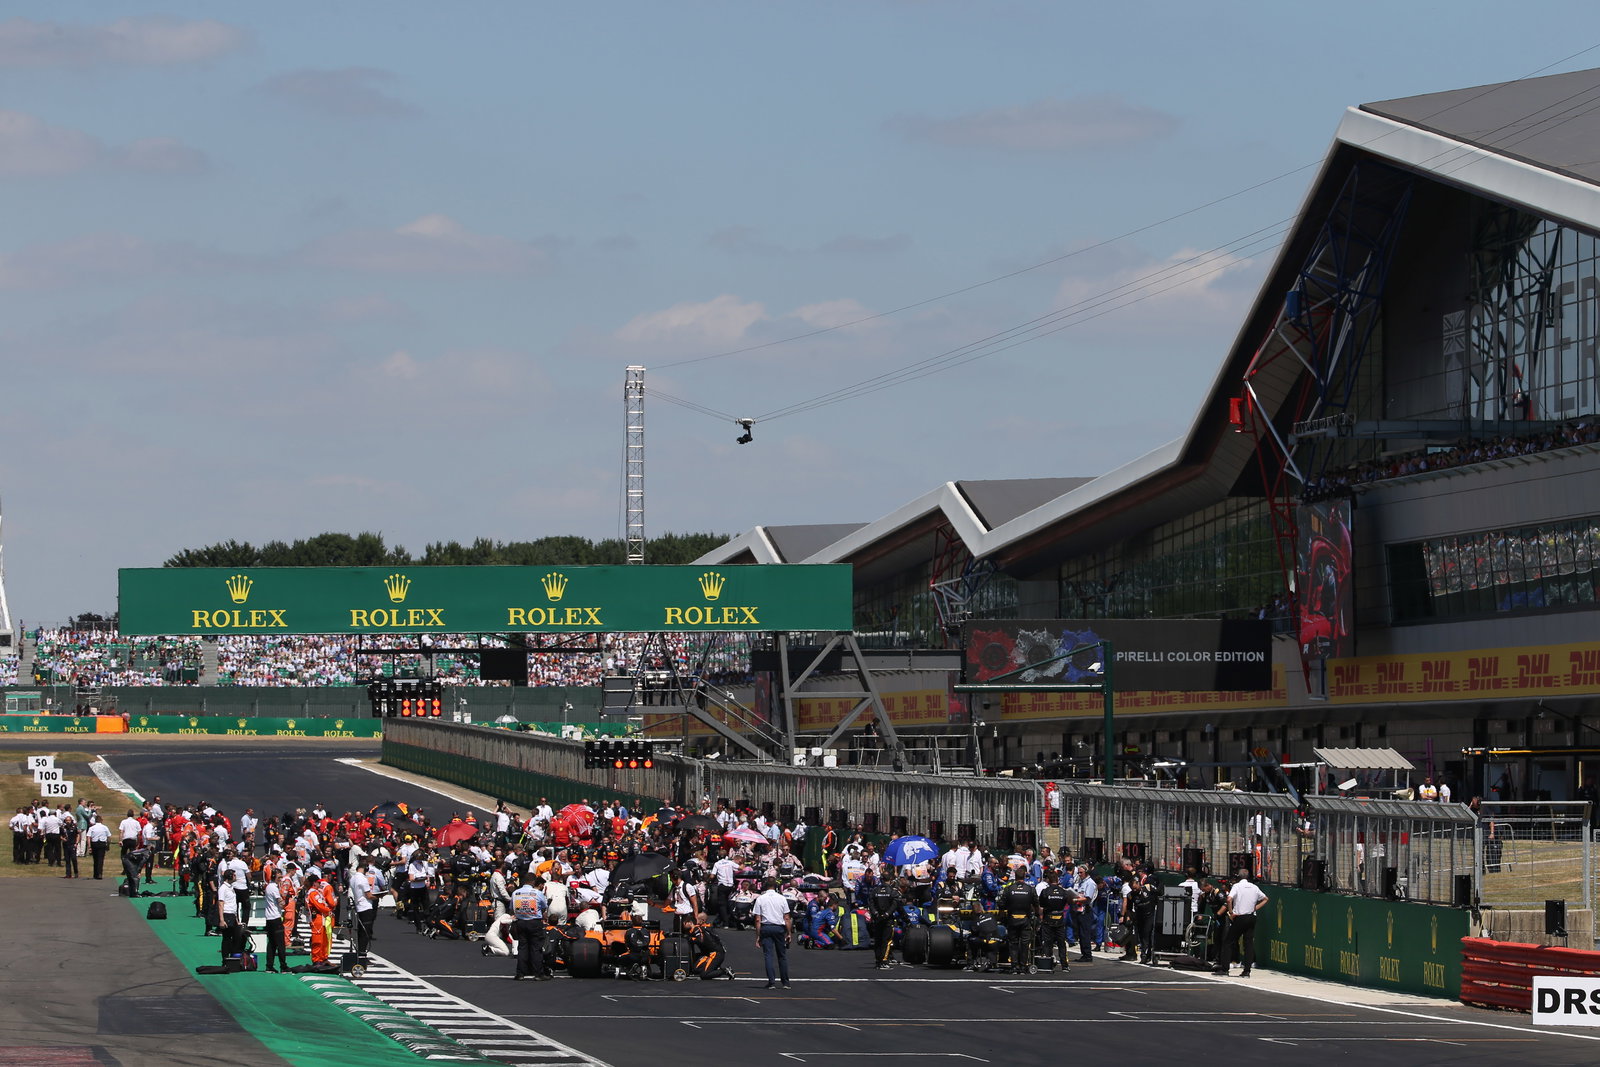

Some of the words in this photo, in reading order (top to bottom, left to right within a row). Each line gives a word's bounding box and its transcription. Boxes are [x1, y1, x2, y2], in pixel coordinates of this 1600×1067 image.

[191, 609, 288, 628] ROLEX
[350, 608, 446, 627] ROLEX
[507, 607, 604, 626] ROLEX
[664, 606, 760, 625] ROLEX
[1116, 651, 1164, 662] PIRELLI
[1167, 651, 1211, 662] COLOR
[1214, 650, 1264, 662] EDITION
[1334, 665, 1364, 696] DHL
[1376, 662, 1407, 694] DHL
[1421, 660, 1454, 693] DHL
[1467, 656, 1503, 691] DHL
[1517, 653, 1554, 688] DHL
[129, 726, 159, 734] ROLEX
[35, 758, 48, 767] 50
[39, 771, 57, 781] 100
[47, 784, 67, 795] 150
[1126, 843, 1139, 857] 10
[1231, 854, 1246, 868] 55
[1271, 939, 1288, 963] ROLEX
[1305, 945, 1323, 970] ROLEX
[1340, 950, 1360, 976] ROLEX
[1380, 956, 1400, 982] ROLEX
[1424, 961, 1445, 988] ROLEX
[1538, 987, 1600, 1015] DRS
